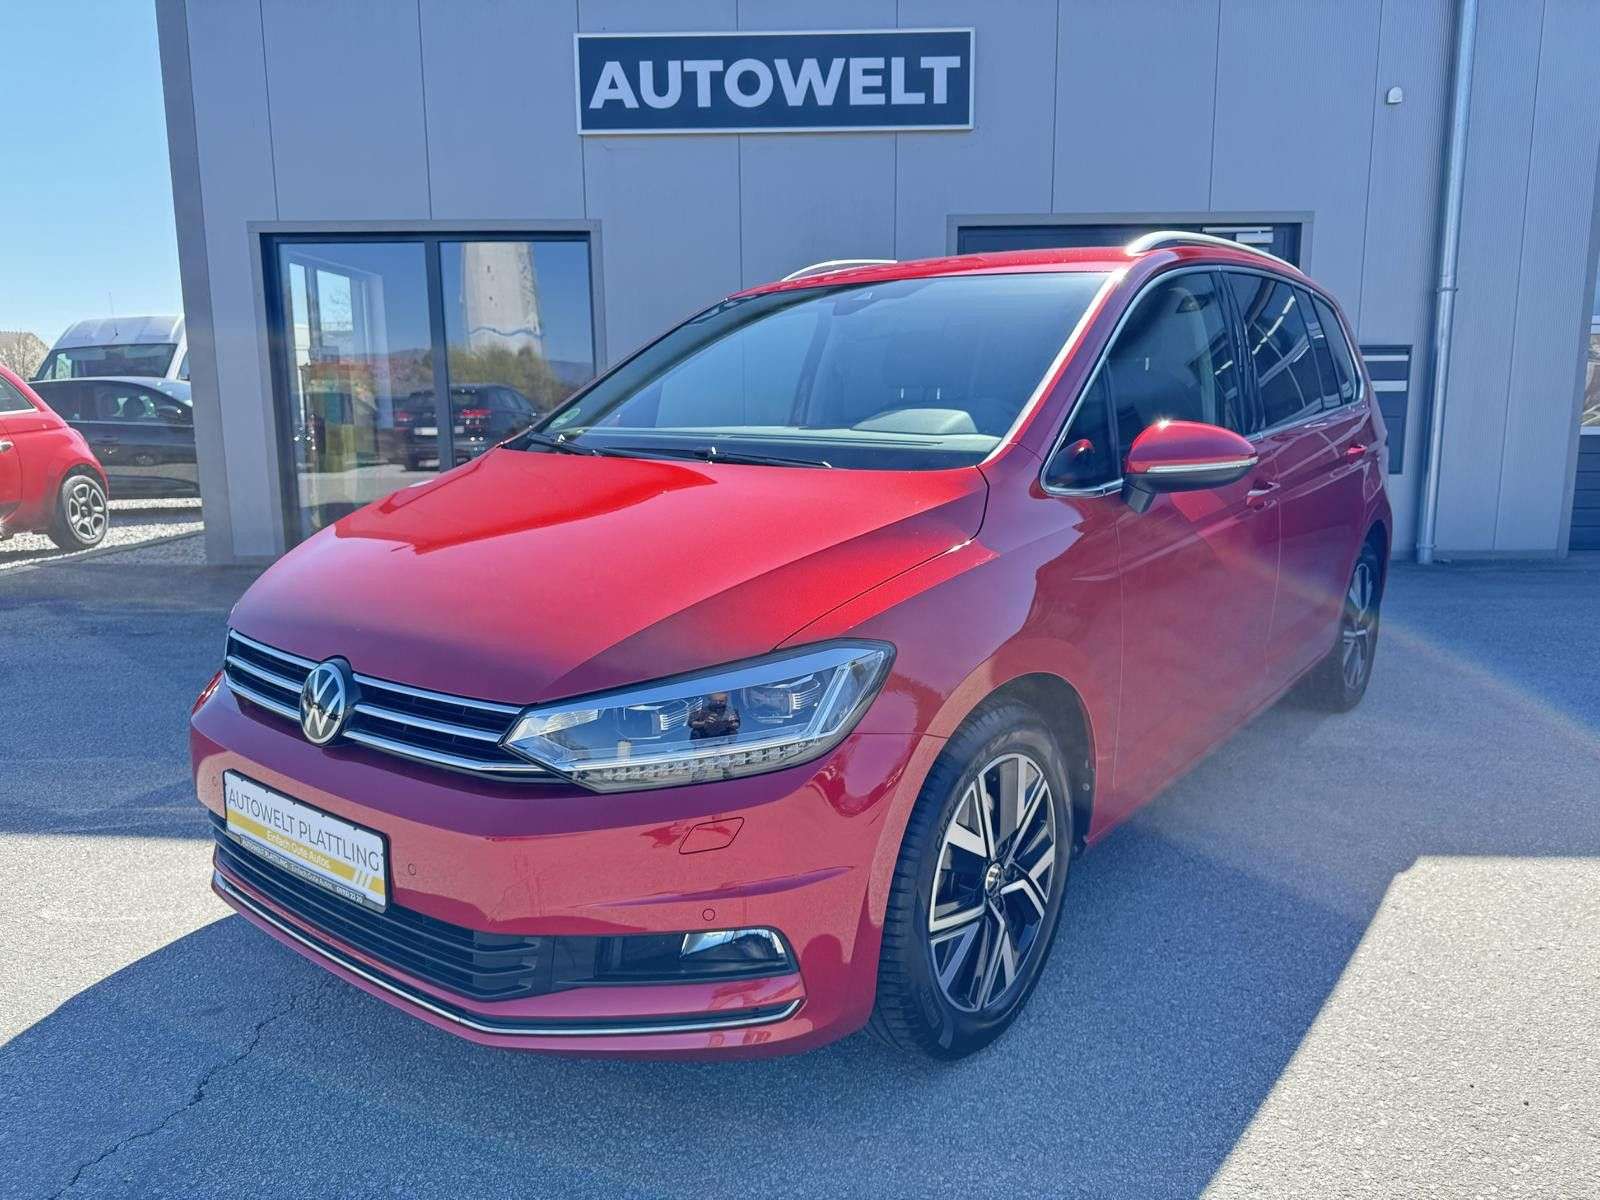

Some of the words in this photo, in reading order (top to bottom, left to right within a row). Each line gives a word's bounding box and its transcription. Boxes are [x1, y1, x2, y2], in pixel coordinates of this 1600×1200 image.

[588, 56, 961, 109] AUTOWELT
[227, 788, 295, 835] AUTOWELT
[299, 820, 380, 872] PLATTLING
